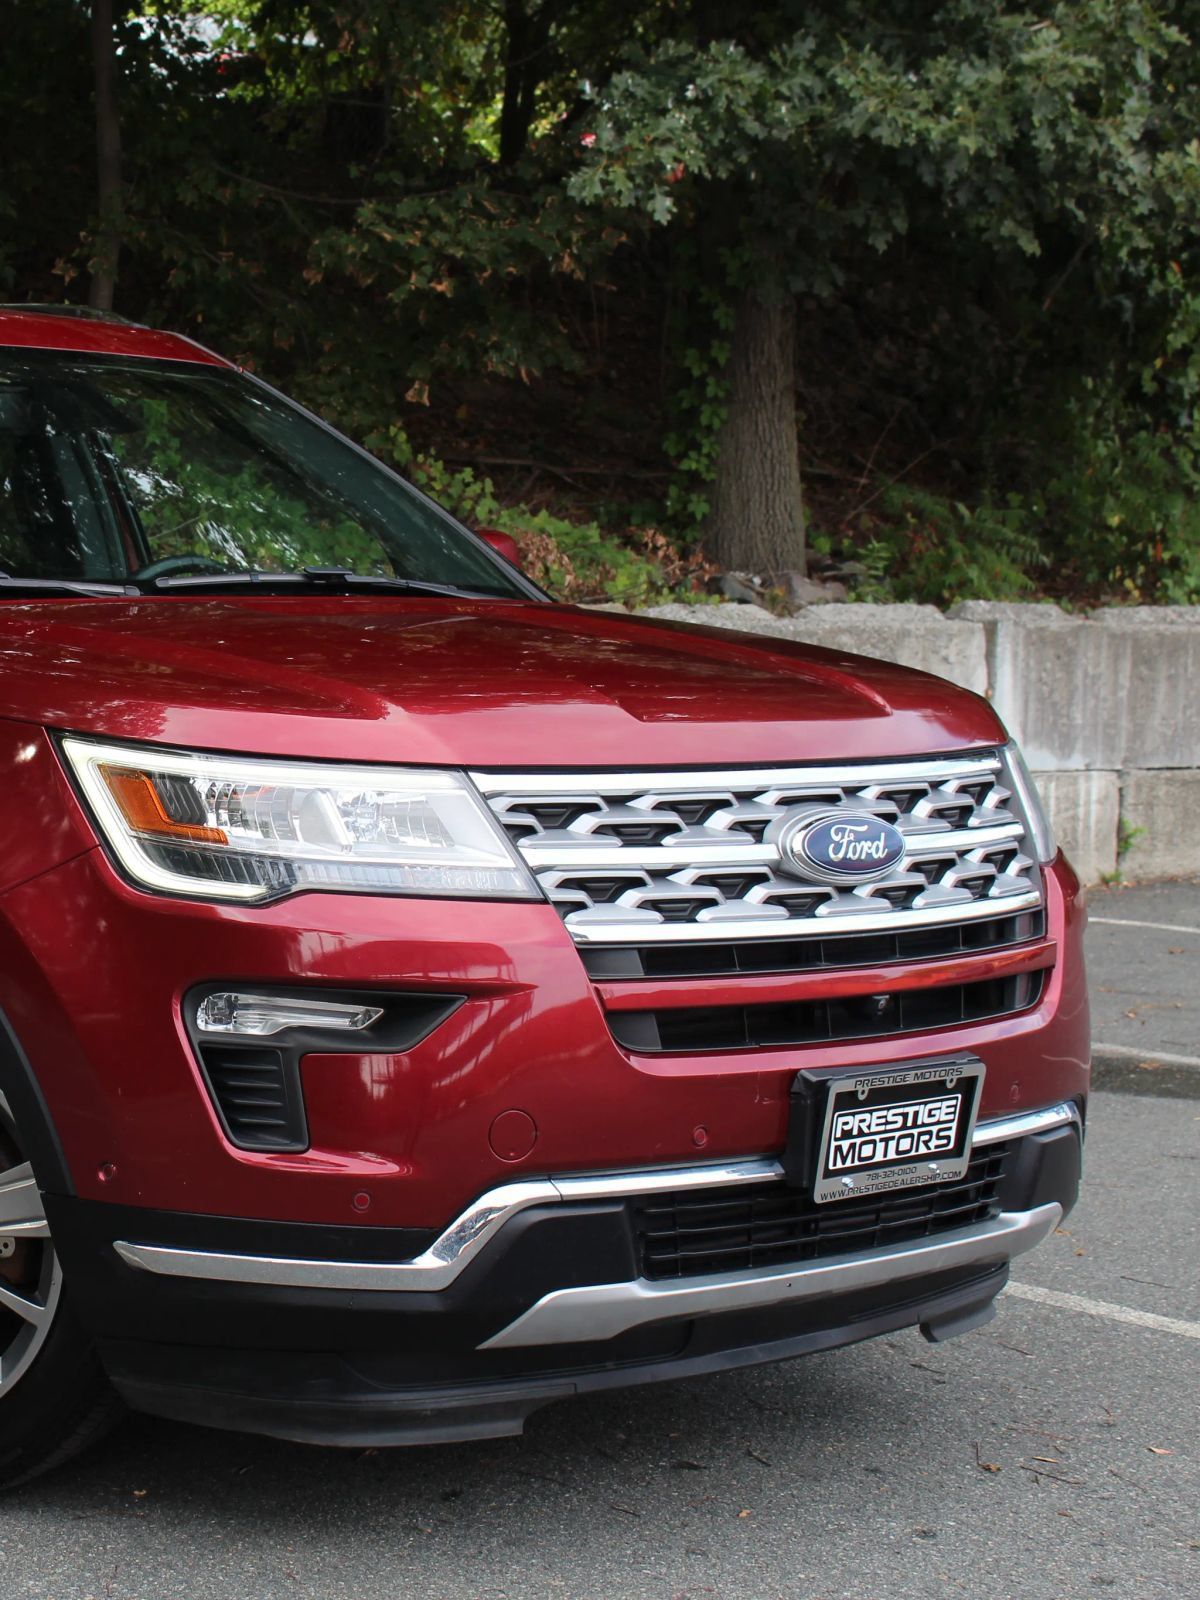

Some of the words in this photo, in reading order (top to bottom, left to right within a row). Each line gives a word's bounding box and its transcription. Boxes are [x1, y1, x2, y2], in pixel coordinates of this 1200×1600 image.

[828, 824, 888, 861] Ford
[854, 1075, 911, 1089] PRESTIGE
[913, 1067, 963, 1081] MOTORS
[835, 1100, 957, 1138] PRESTIGE
[832, 1127, 951, 1167] MOTORS
[820, 1171, 962, 1201] WWW.PRESTIGEDEALERSHIP.COM
[865, 1166, 918, 1182] 781-321-0100
